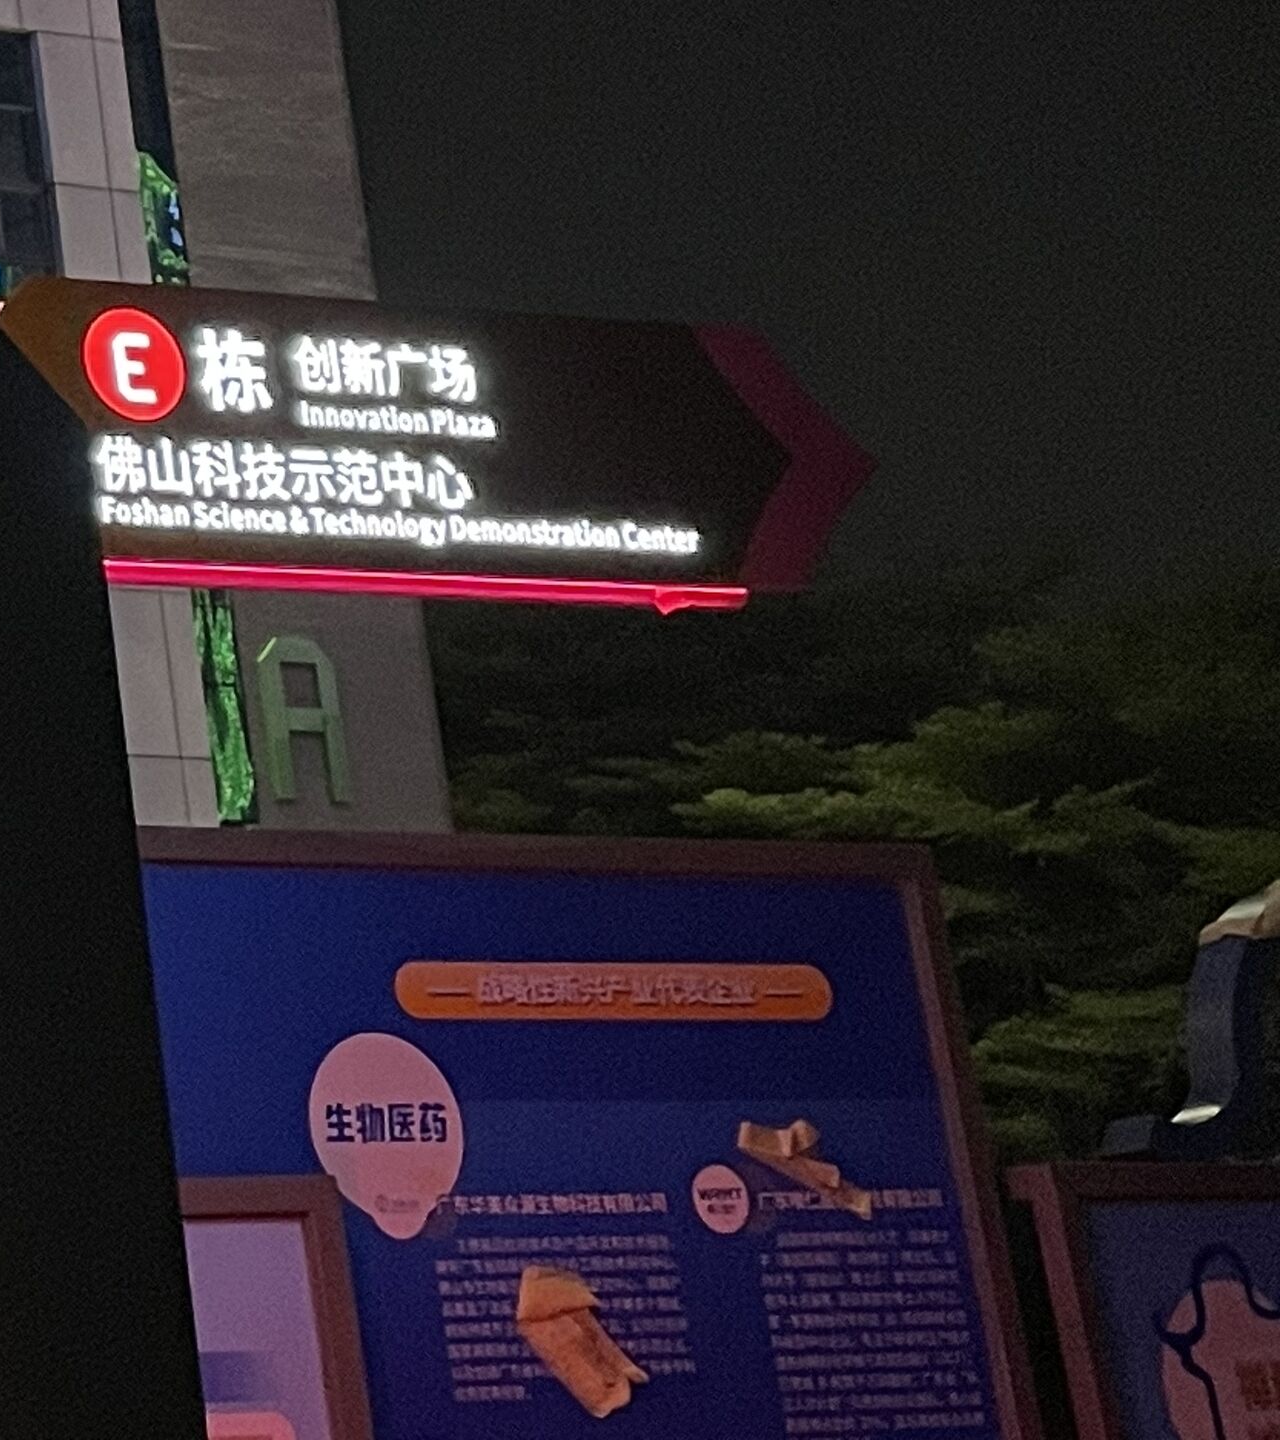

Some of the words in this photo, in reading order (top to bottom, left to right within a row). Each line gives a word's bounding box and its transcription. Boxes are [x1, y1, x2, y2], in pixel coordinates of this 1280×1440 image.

[111, 331, 158, 404] E
[197, 327, 274, 413] 栋
[294, 335, 477, 402] 创新广场
[300, 400, 430, 437] Innovation
[433, 408, 498, 439] Plaza
[96, 434, 474, 509] 佛山科技示范中心
[98, 496, 190, 529] Foshan
[193, 500, 288, 534] Science
[310, 506, 446, 547] Technology
[449, 514, 621, 550] Demonstration
[622, 521, 700, 555] Center
[257, 635, 351, 804] A
[325, 1102, 448, 1144] 生物医药
